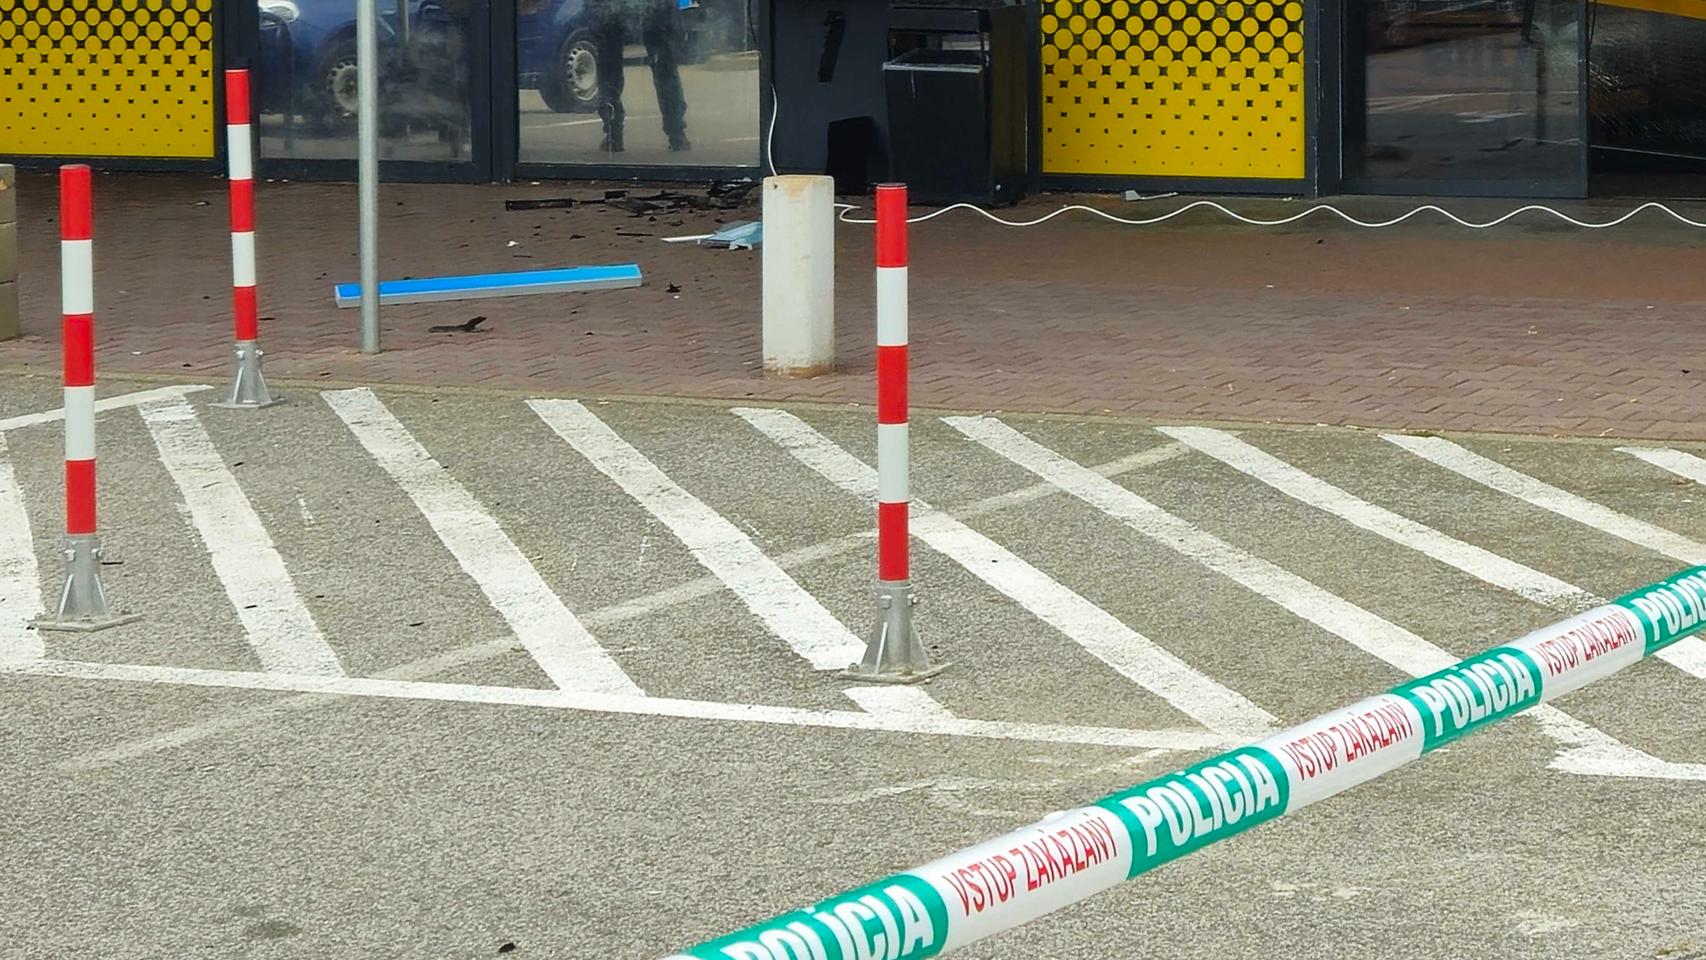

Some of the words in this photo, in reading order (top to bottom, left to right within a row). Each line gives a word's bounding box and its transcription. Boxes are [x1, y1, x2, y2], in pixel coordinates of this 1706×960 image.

[1409, 653, 1535, 738] POLÍCIA
[1529, 635, 1580, 677] VSTUP
[1280, 731, 1338, 781] VSTUP
[1328, 698, 1413, 762] ZAKÁZANÝ
[1119, 754, 1280, 857] POLÍCIA
[942, 855, 1017, 917] VSTUP
[1009, 812, 1118, 891] ZAKÁZANÝ
